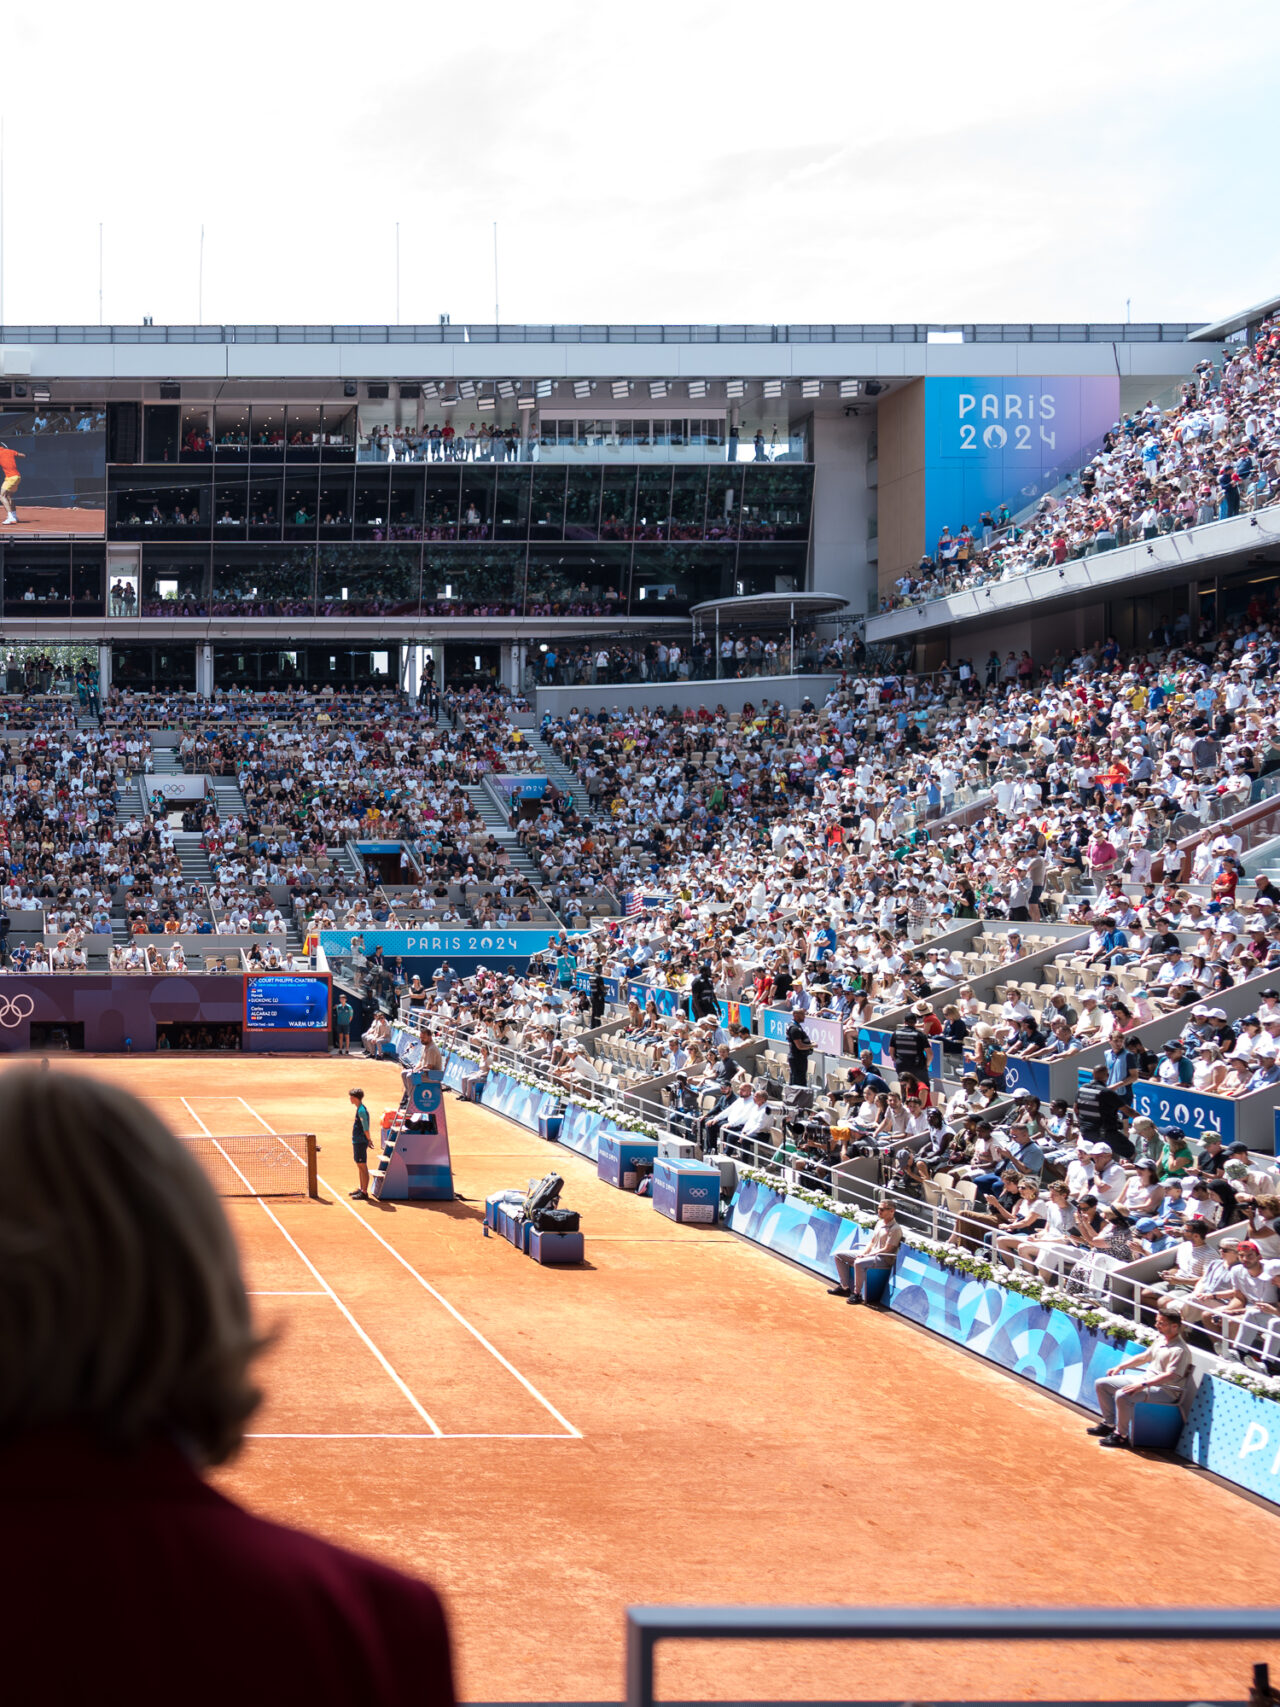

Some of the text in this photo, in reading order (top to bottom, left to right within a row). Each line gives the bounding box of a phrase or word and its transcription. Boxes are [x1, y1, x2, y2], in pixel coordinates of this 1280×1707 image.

[960, 424, 1055, 449] 2024
[468, 937, 517, 950] 2024
[1160, 1100, 1221, 1132] 2024
